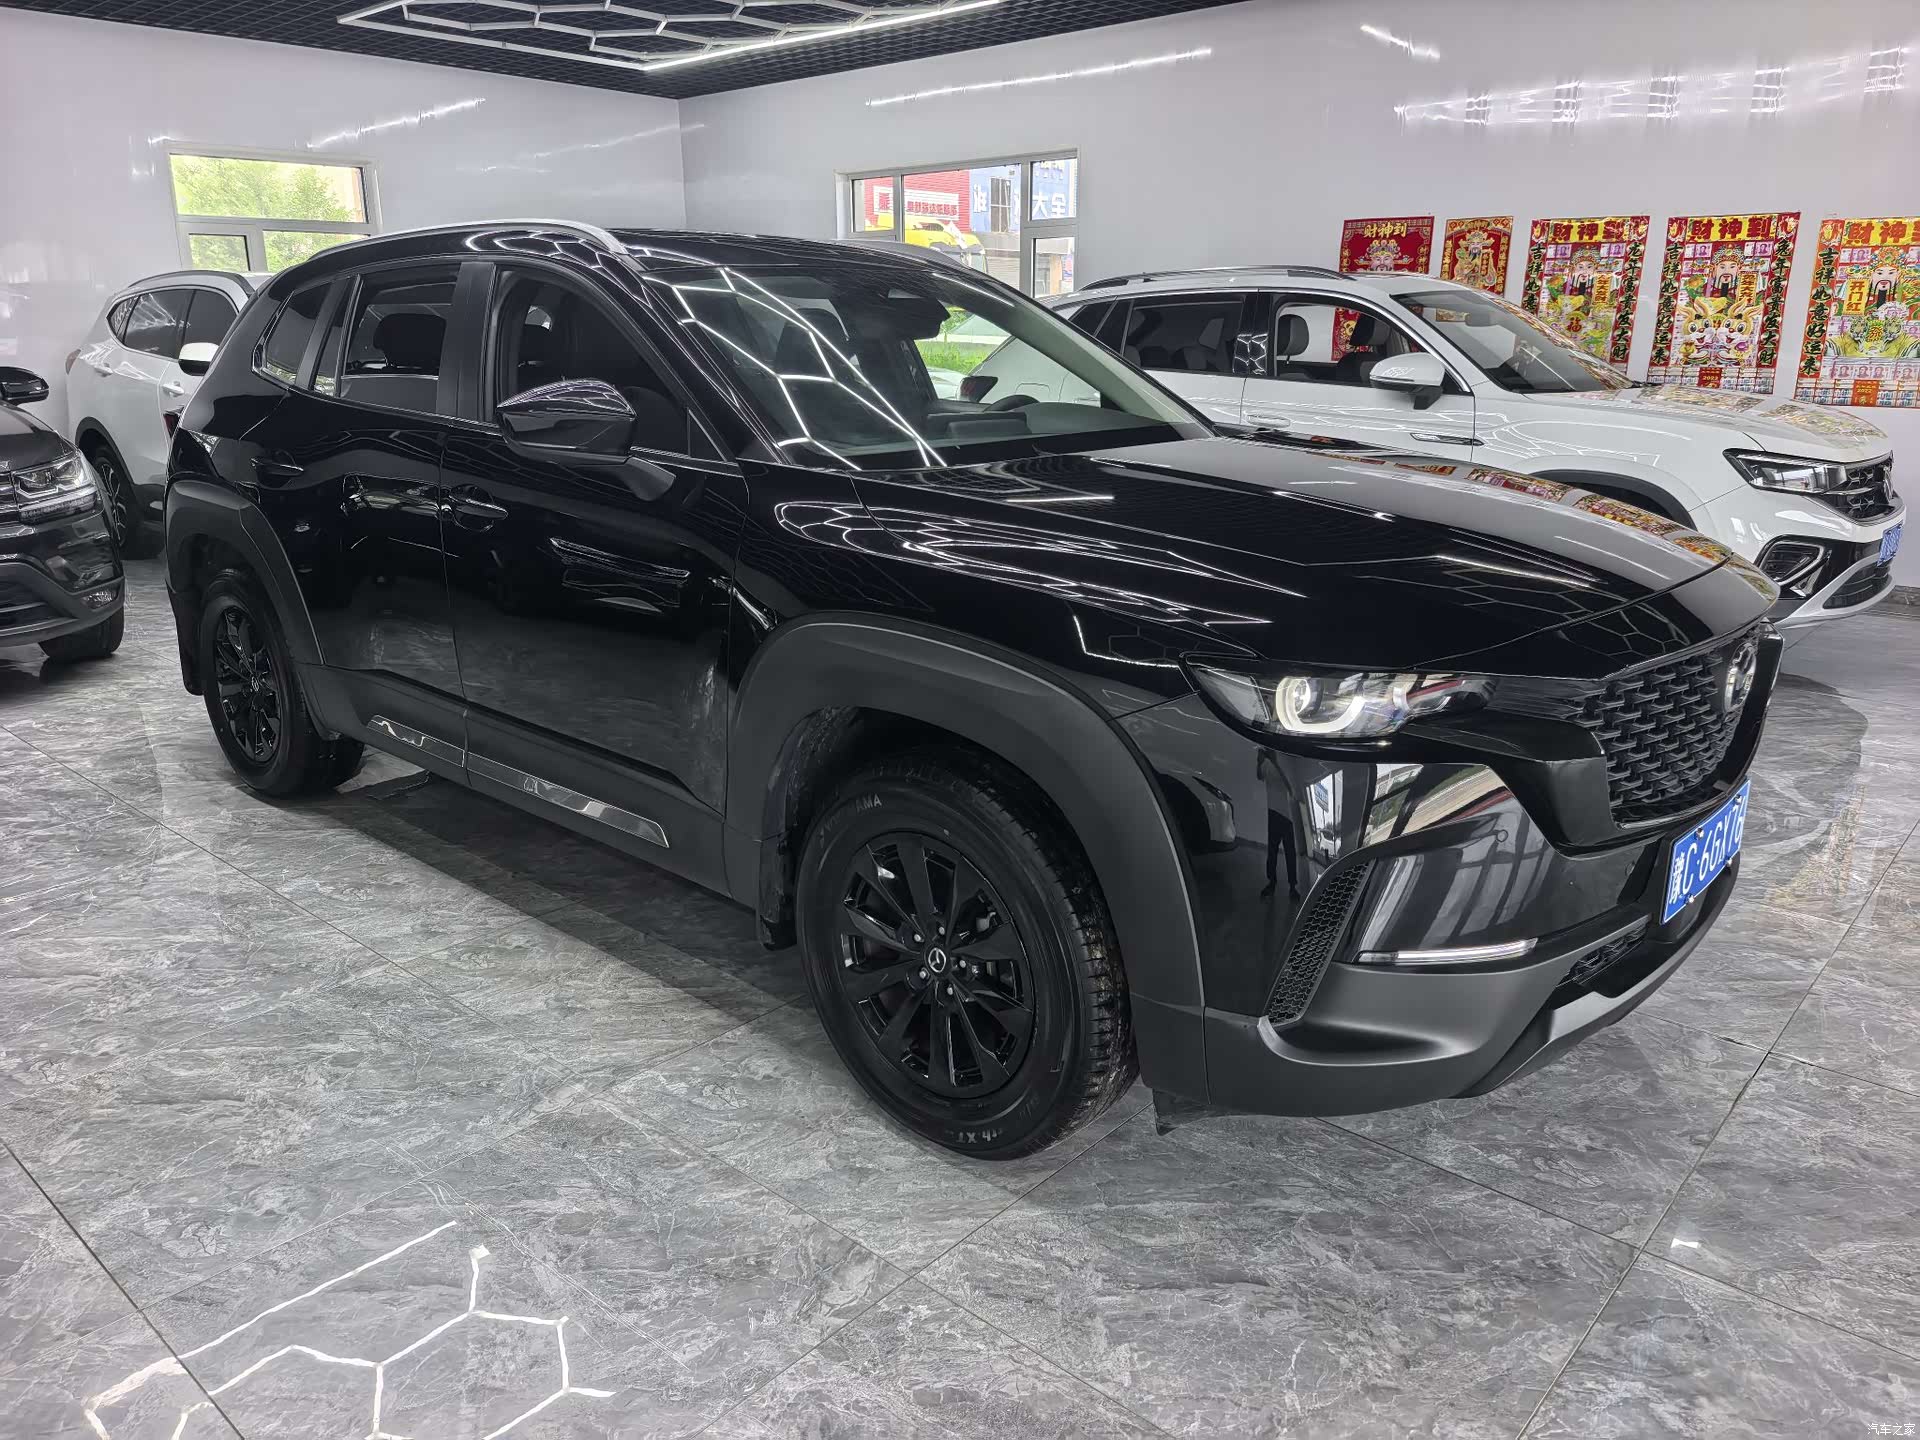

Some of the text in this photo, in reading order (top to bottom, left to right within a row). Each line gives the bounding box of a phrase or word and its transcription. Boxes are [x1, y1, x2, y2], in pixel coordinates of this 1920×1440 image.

[1363, 222, 1408, 239] 财神到
[1652, 242, 1683, 365] 吉祥如意好运来
[1758, 238, 1791, 365] 兔年富贵发大财
[1801, 248, 1839, 375] 吉祥如意好运来
[1845, 280, 1865, 313] 开门红
